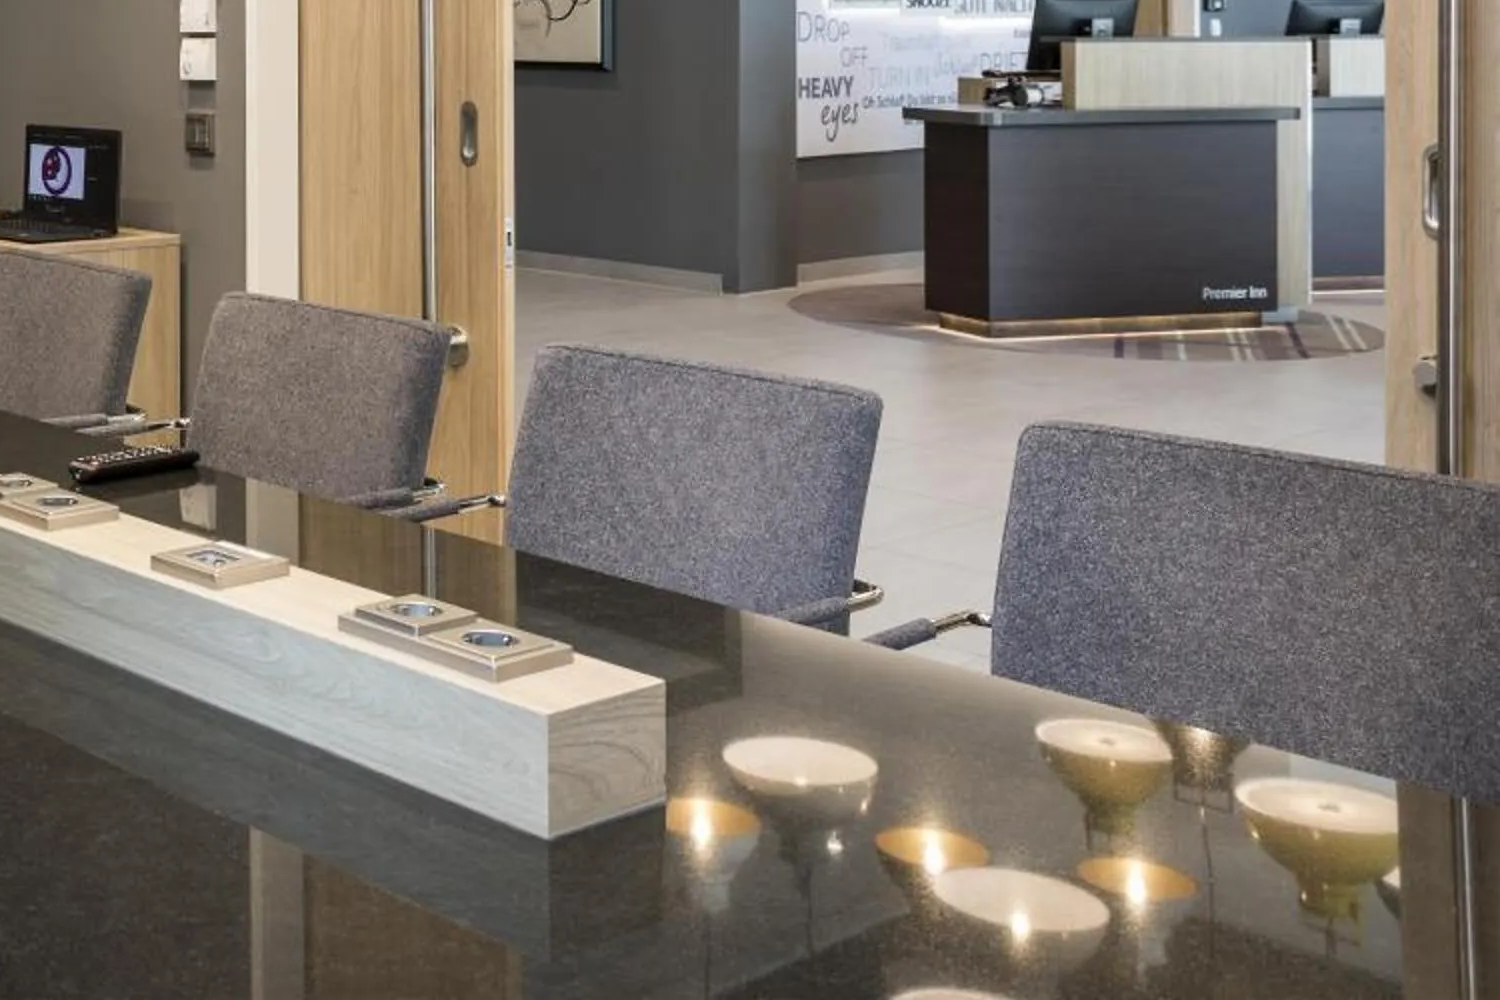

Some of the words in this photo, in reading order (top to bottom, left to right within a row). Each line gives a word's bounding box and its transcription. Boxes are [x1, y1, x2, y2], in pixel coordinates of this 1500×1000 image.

[797, 10, 850, 43] DROP
[840, 47, 869, 68] OFF
[798, 75, 854, 100] HEAVY
[820, 102, 860, 142] eyes
[1203, 286, 1248, 300] Premier
[1249, 285, 1267, 299] Inn
